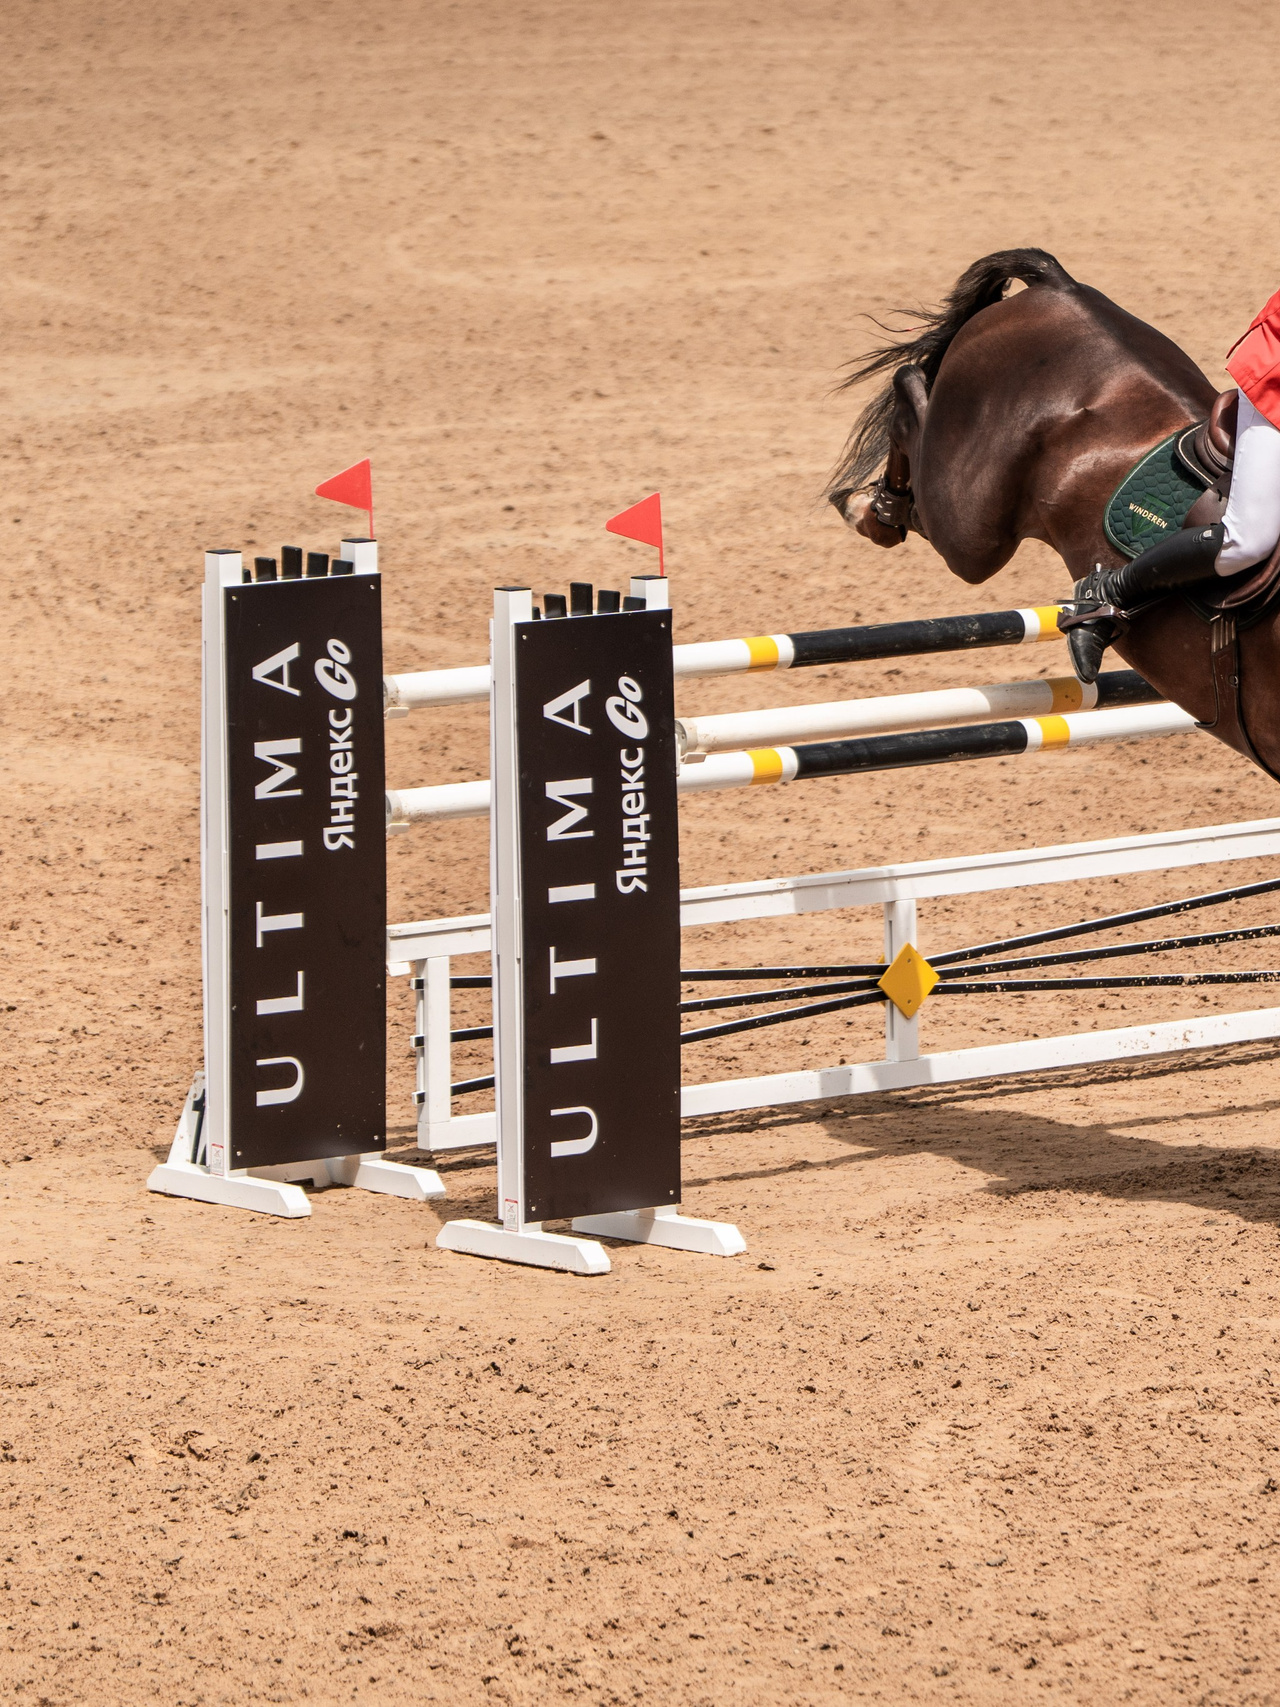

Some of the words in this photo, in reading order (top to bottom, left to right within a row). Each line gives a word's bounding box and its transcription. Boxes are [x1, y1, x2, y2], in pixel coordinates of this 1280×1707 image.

[1128, 502, 1168, 529] WINDEREN
[314, 638, 357, 701] Go
[605, 676, 649, 740] Go
[322, 707, 359, 851] Яндекс
[615, 747, 651, 894] Яндекс
[252, 641, 305, 1107] ULTIMA
[542, 678, 599, 1158] ULTIMA
